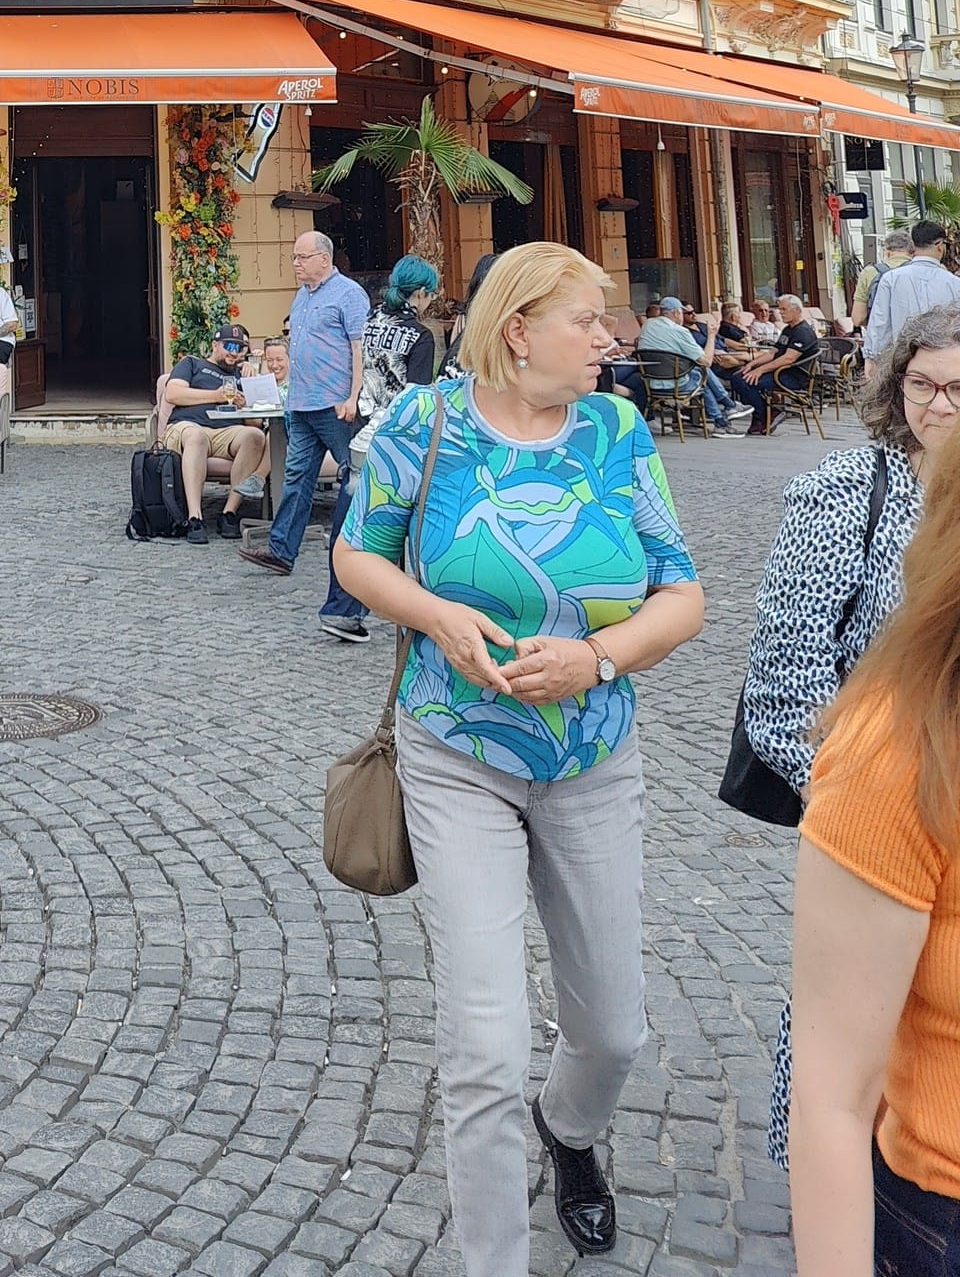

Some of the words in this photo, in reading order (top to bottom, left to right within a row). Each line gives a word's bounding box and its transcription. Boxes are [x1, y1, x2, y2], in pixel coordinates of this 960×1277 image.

[68, 79, 139, 95] NOBIS
[277, 78, 323, 95] APEROL
[286, 89, 316, 101] SPRITZ
